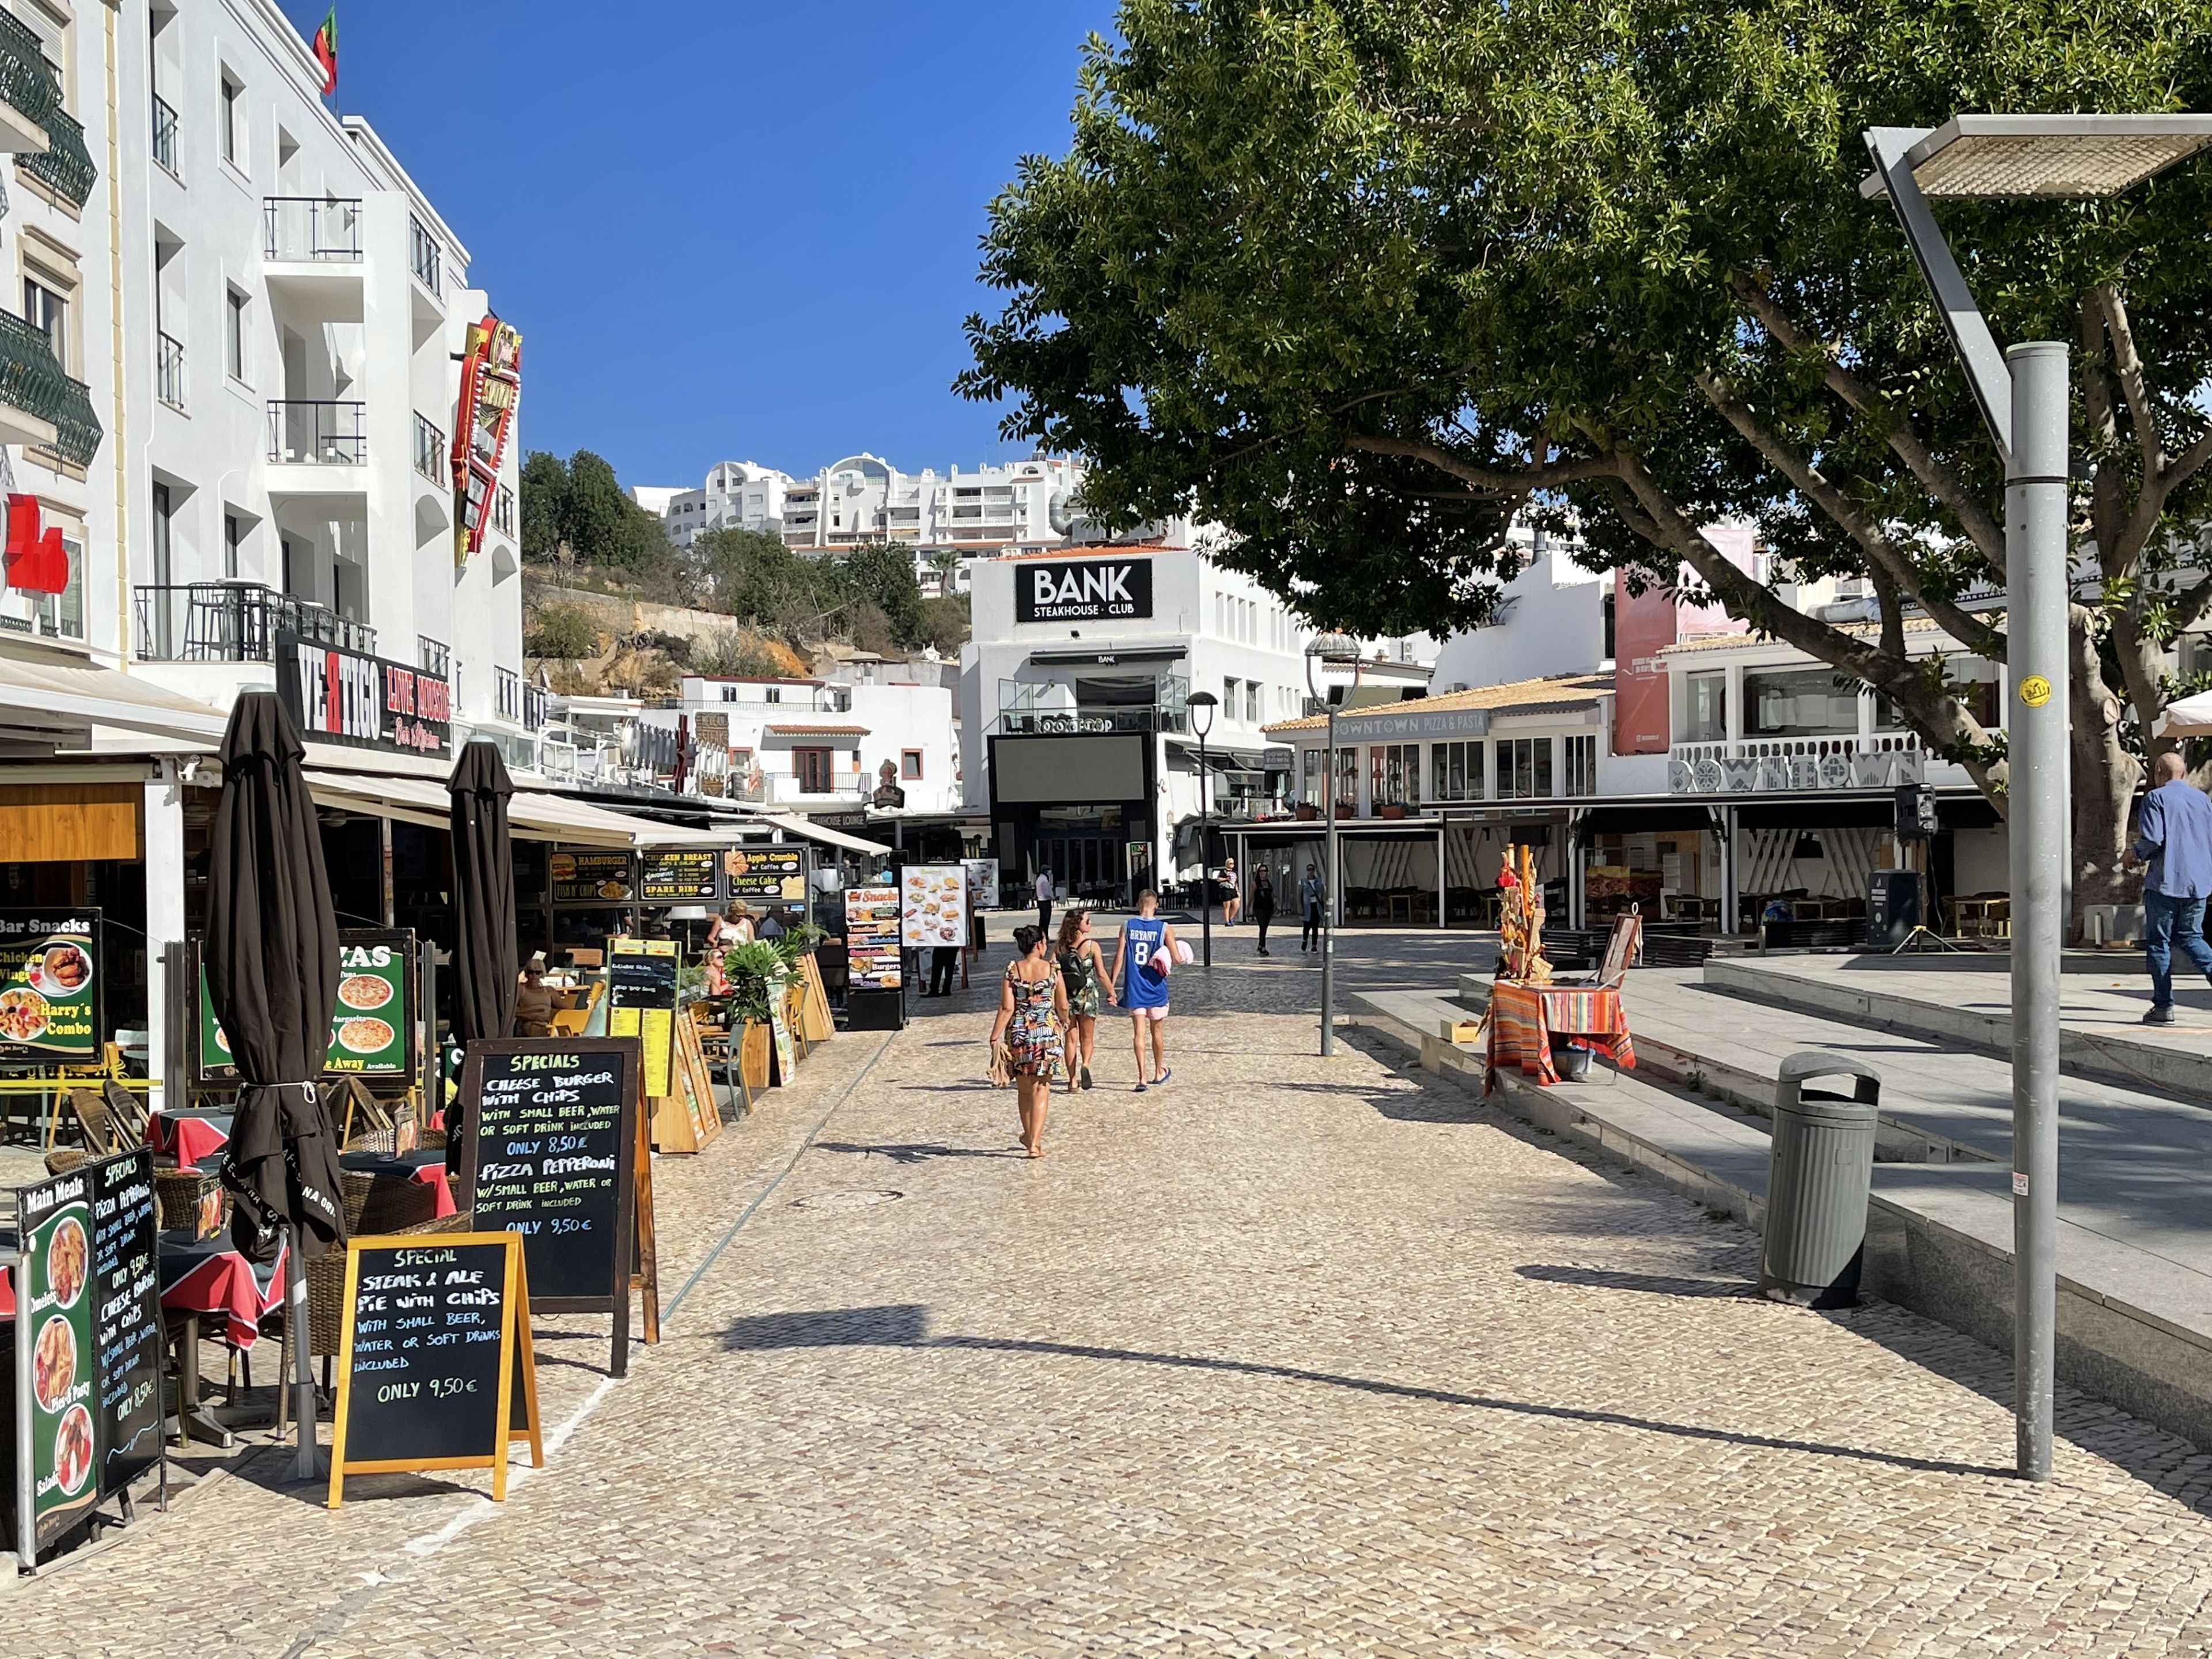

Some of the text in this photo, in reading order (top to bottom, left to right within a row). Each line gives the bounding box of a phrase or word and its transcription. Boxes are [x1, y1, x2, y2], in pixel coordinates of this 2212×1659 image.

[1034, 566, 1133, 604] BANK
[1034, 603, 1134, 618] STEAKHOUSE CLUB
[1098, 656, 1115, 664] BANK
[297, 642, 381, 741] VERTIGO
[387, 665, 414, 715] LIVE
[1424, 717, 1446, 732] PIZZA
[1449, 717, 1455, 729] &
[1457, 715, 1483, 729] PASTA
[578, 856, 627, 865] HAMBURGER
[747, 854, 767, 863] Apple
[732, 876, 777, 885] Cheese Cake
[862, 890, 898, 902] Snacks
[29, 918, 90, 933] Snacks
[1130, 929, 1158, 942] BRYANT
[1135, 942, 1148, 965] 8
[47, 1022, 92, 1035] Combo
[334, 1057, 364, 1070] Away
[510, 1054, 580, 1072] SPECIALS
[552, 1071, 614, 1088] BURGER
[482, 1089, 580, 1107] WITH CHIPS
[482, 1109, 511, 1122] WITH
[519, 1106, 554, 1119] SMALL
[480, 1126, 495, 1137] OR
[502, 1123, 529, 1135] SOFT
[534, 1120, 565, 1134] DRINK
[506, 1141, 540, 1156] ONLY
[105, 1156, 137, 1187] SPECIALS
[601, 1179, 612, 1187] OR
[26, 1176, 84, 1214] Main Meals
[476, 1197, 582, 1214] SOFT DRINK INCLUDED
[505, 1218, 592, 1234] ONLY 9,50€
[393, 1249, 457, 1267] SPECIAL
[112, 1267, 127, 1289] ONLY
[426, 1272, 437, 1286] &
[445, 1270, 484, 1286] ALE
[357, 1288, 501, 1314] PIE WITH CHIPS
[121, 1304, 142, 1328] CHIPS
[357, 1312, 486, 1334] WITH SMALL BEER,
[354, 1330, 501, 1353] WATER OR SOFT DRINKS
[354, 1357, 410, 1373] INCLUDED
[101, 1375, 111, 1389] OR
[113, 1365, 124, 1381] SOFT
[377, 1377, 478, 1403] ONLY 9,50€
[51, 1395, 65, 1414] Pies
[118, 1395, 133, 1422] ONLY
